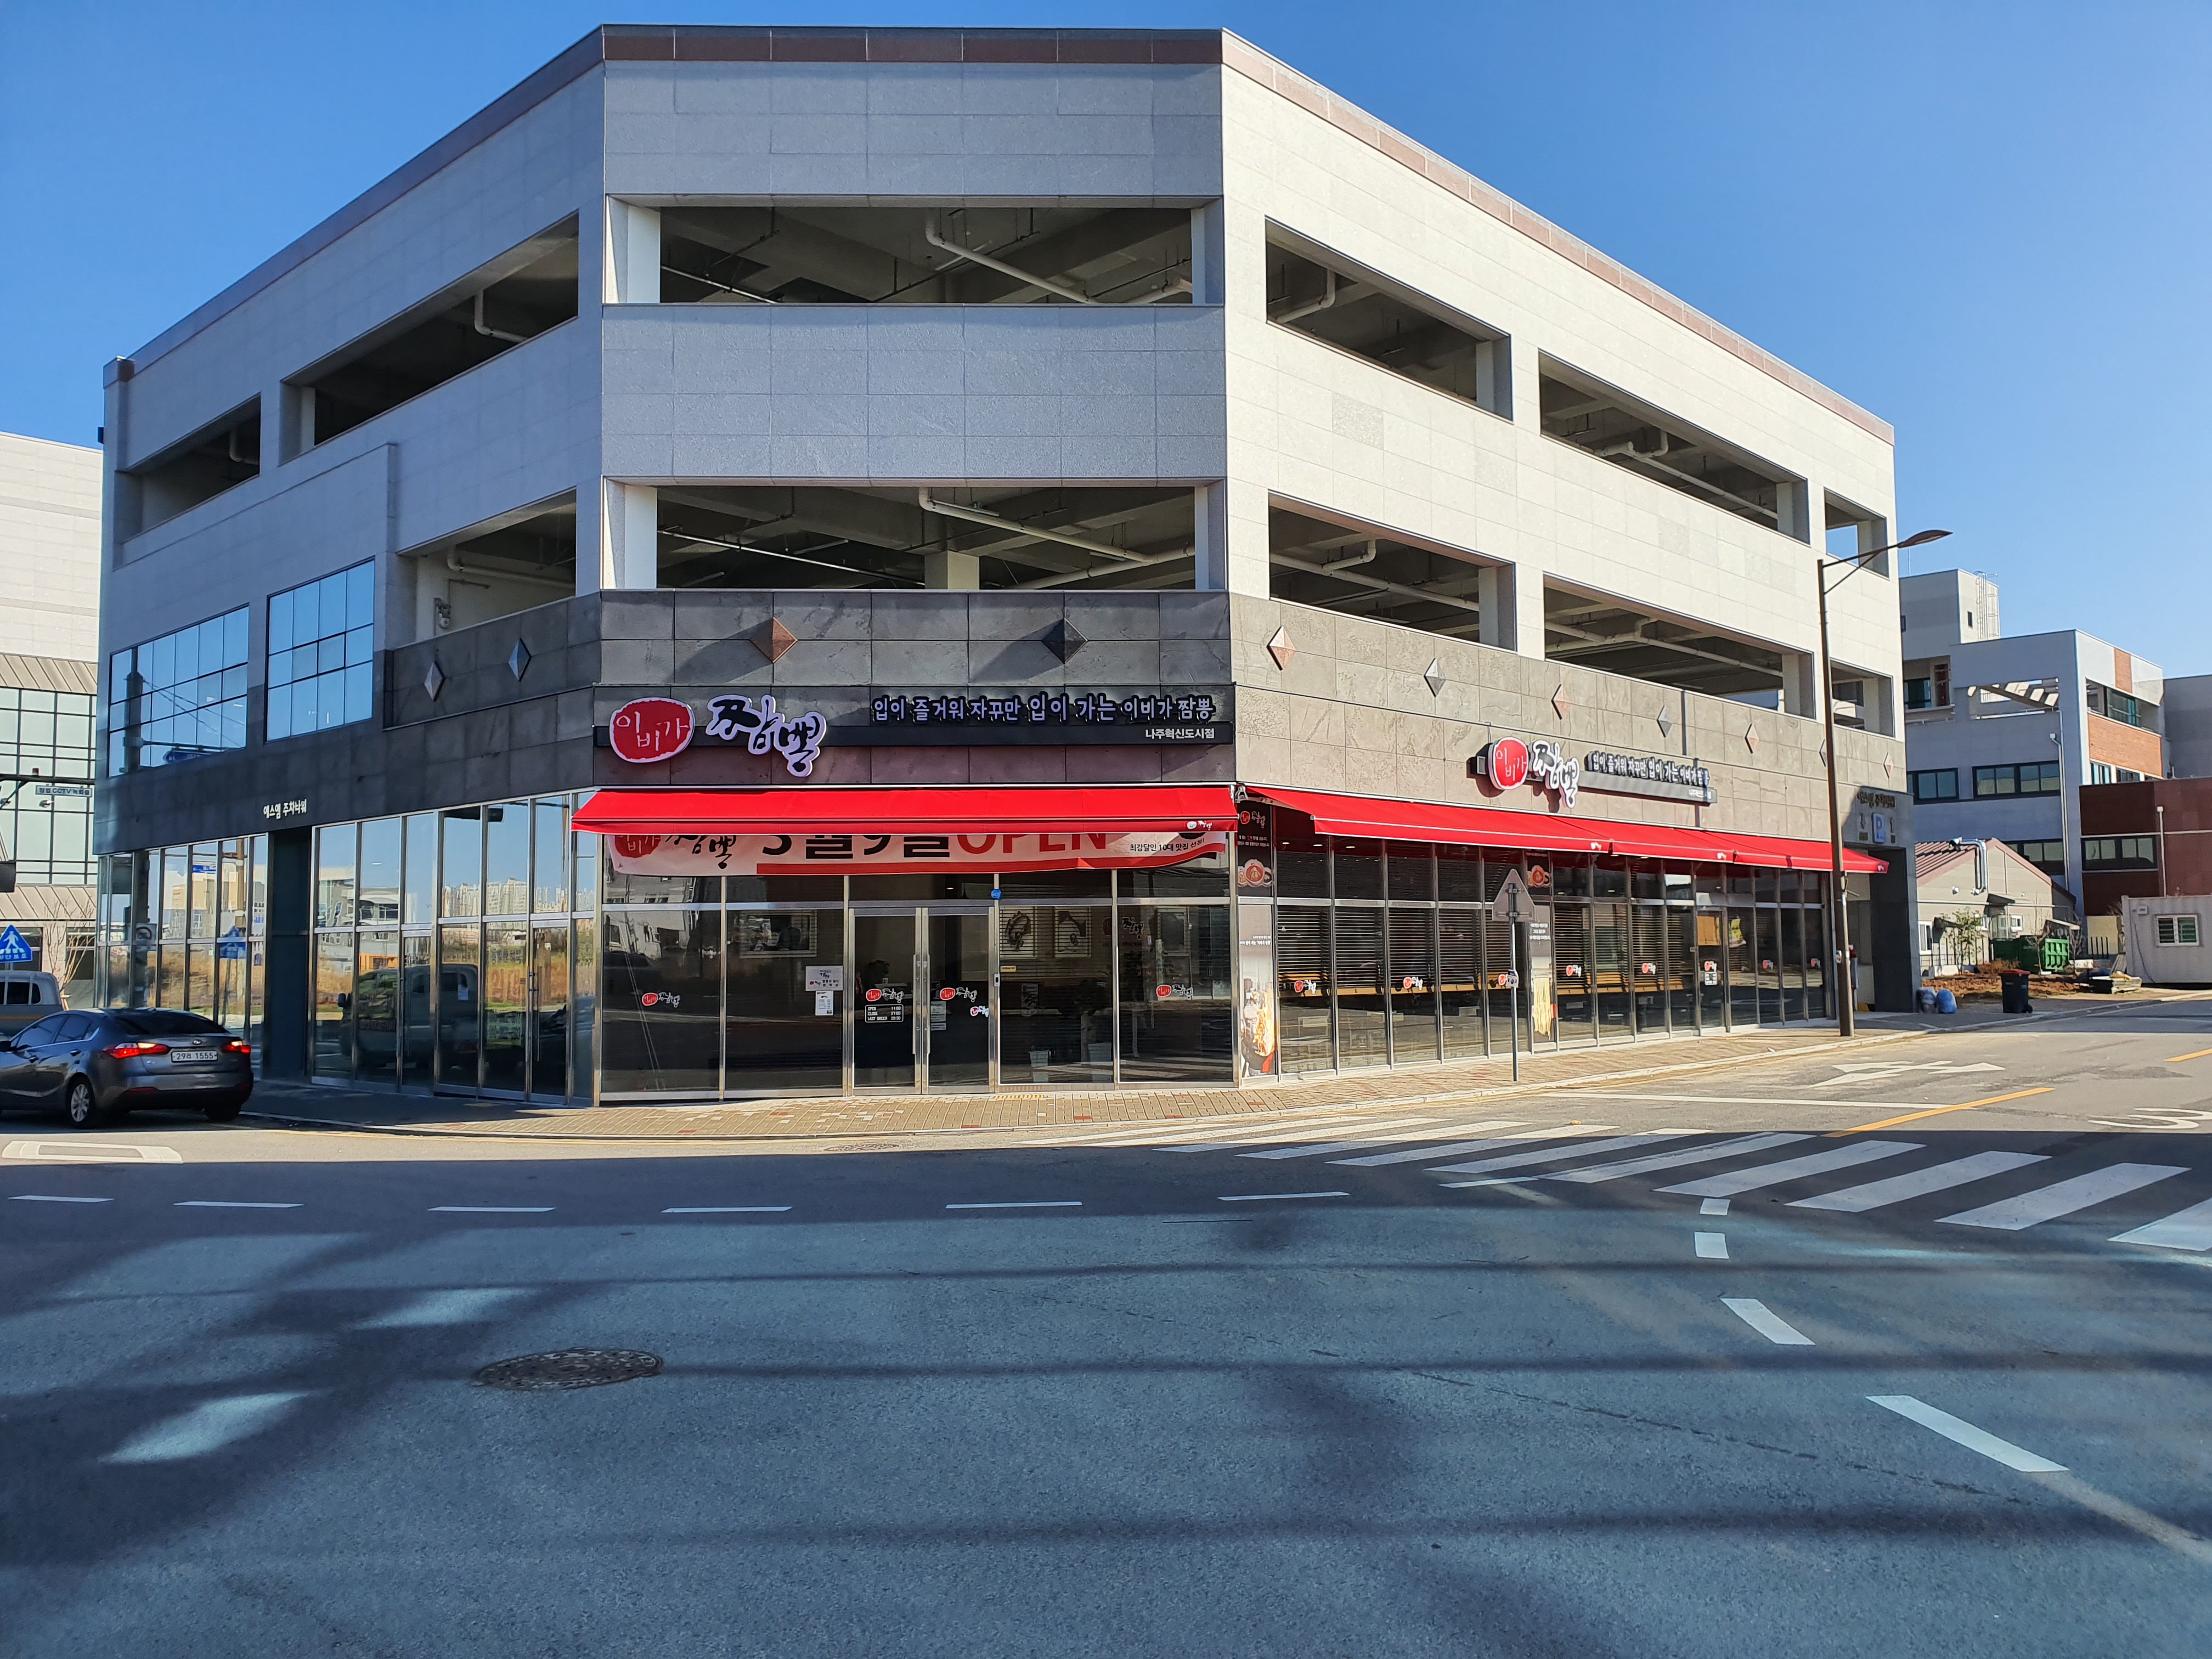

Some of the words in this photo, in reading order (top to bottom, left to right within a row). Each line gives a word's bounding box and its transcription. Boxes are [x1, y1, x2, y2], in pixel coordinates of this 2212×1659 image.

[874, 697, 905, 721] 입이
[913, 698, 964, 721] 즐거워
[970, 698, 1021, 721] 자꾸만
[1029, 694, 1067, 721] 입이
[1076, 695, 1116, 721] 가는
[1124, 695, 1173, 719] 이비가
[1178, 696, 1214, 720] 짬뽕
[614, 707, 690, 754] 이비가
[709, 697, 823, 774] 짬뽕
[1144, 728, 1215, 740] 나주혁신도시점
[1495, 744, 1527, 784] 이비가
[1593, 752, 1607, 770] 입이
[1607, 754, 1627, 775] 즐거워
[1628, 757, 1647, 777] 자꾸만
[1648, 757, 1663, 780] 입이
[1664, 761, 1679, 782] 가는
[1680, 765, 1697, 785] 이비가
[263, 803, 281, 820] 에스엠
[1129, 843, 1157, 852] 최강달인
[1159, 843, 1174, 851] 10대
[1175, 842, 1189, 851] 맛집
